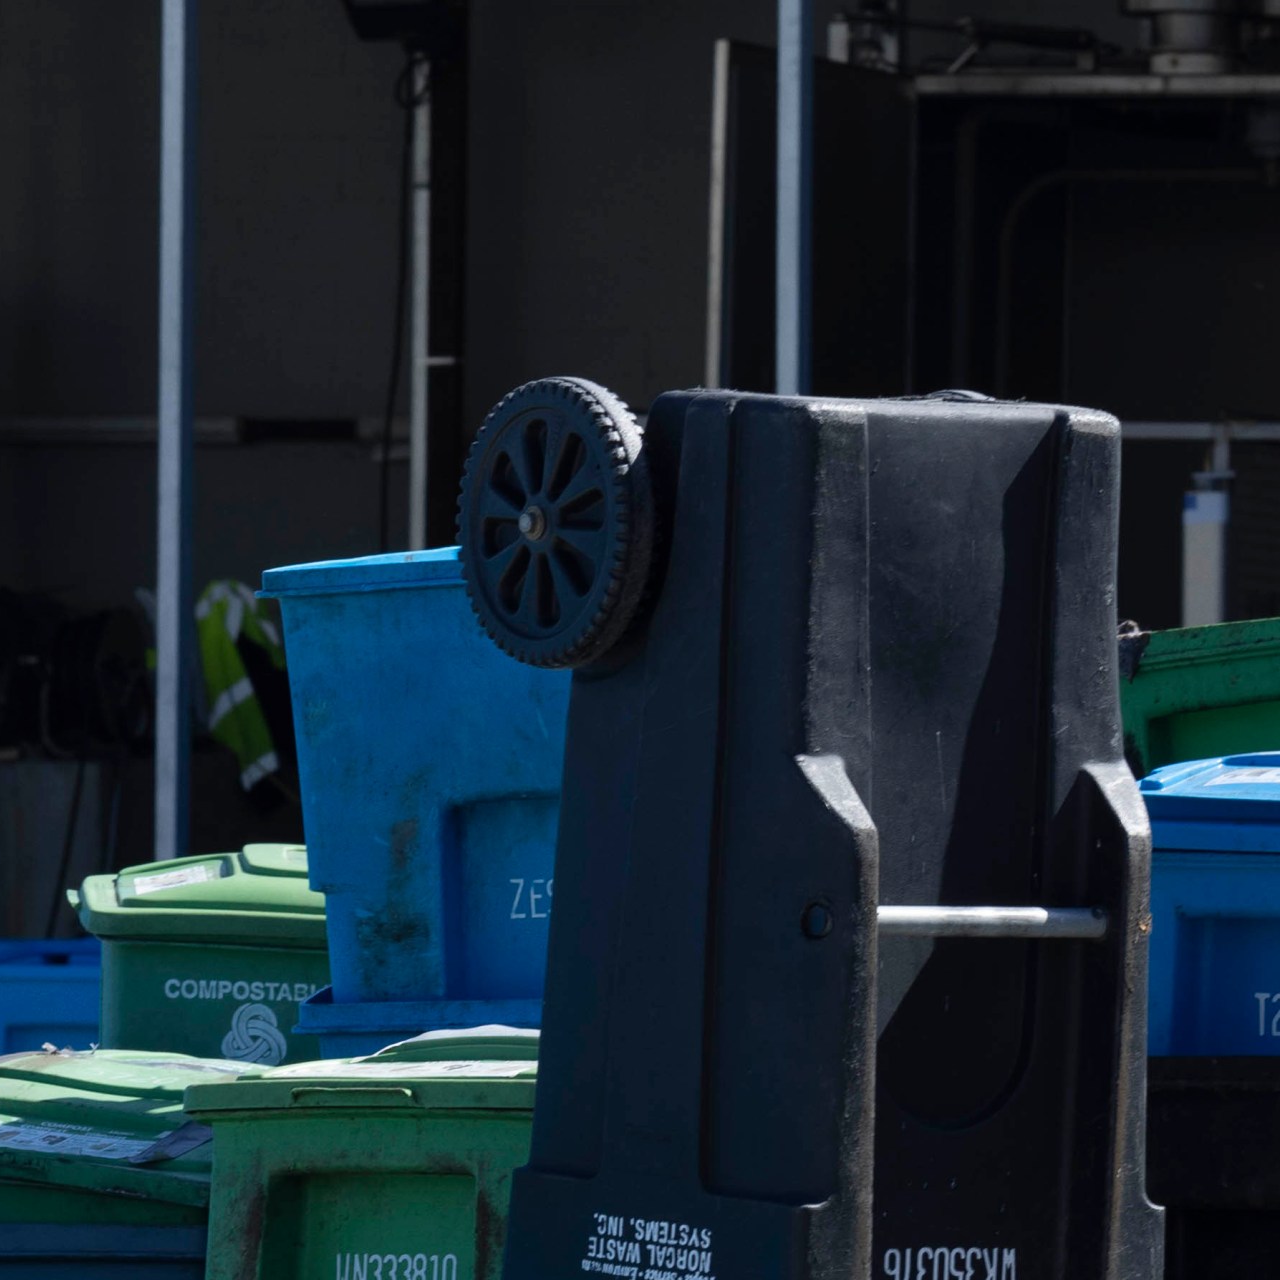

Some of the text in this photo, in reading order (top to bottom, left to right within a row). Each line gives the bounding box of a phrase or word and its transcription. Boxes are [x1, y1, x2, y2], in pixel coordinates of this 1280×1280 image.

[593, 1212, 712, 1249] SYSTEMS, INC.
[587, 1237, 712, 1273] NORCAL WASTE
